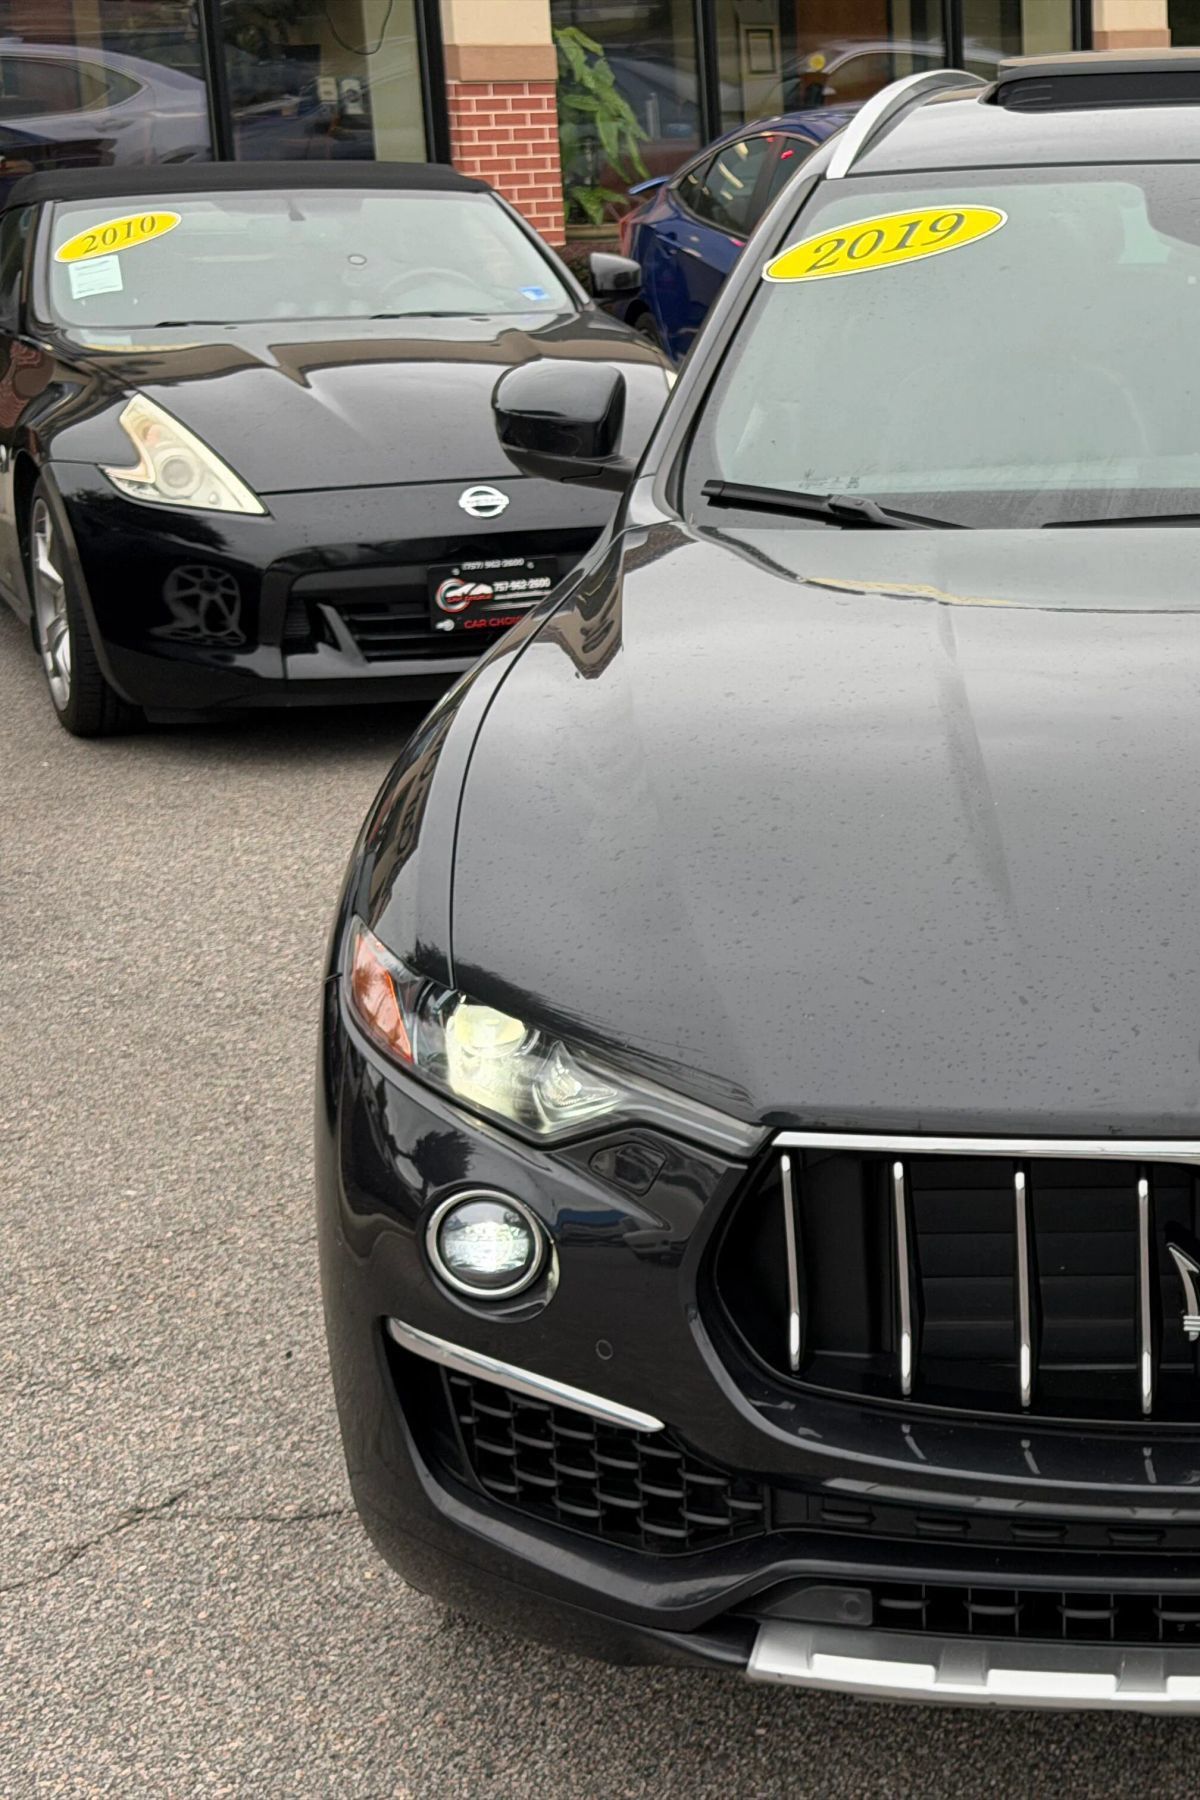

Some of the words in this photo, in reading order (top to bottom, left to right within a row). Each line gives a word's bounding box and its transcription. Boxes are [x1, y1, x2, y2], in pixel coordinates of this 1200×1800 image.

[81, 215, 156, 254] 2010
[804, 212, 966, 273] 2019
[464, 619, 487, 629] CAR
